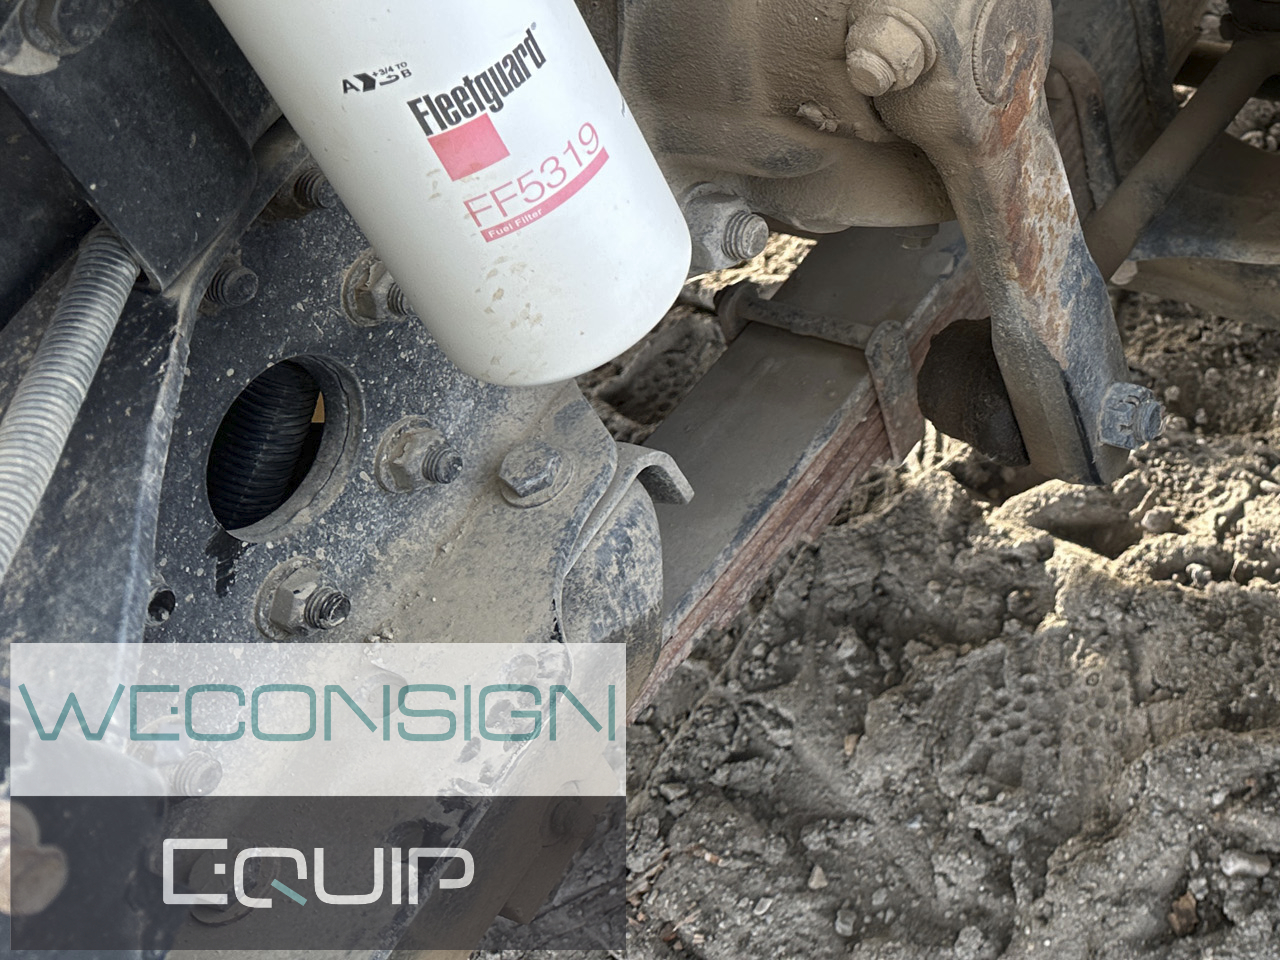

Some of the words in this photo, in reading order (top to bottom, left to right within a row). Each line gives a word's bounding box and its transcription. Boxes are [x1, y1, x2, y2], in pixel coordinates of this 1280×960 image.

[395, 61, 408, 70] TO
[400, 68, 413, 79] B
[342, 78, 361, 94] A
[406, 27, 547, 137] Fleetguard
[463, 121, 600, 228] FF5319
[487, 223, 514, 239] Fuel
[514, 208, 543, 228] Filter
